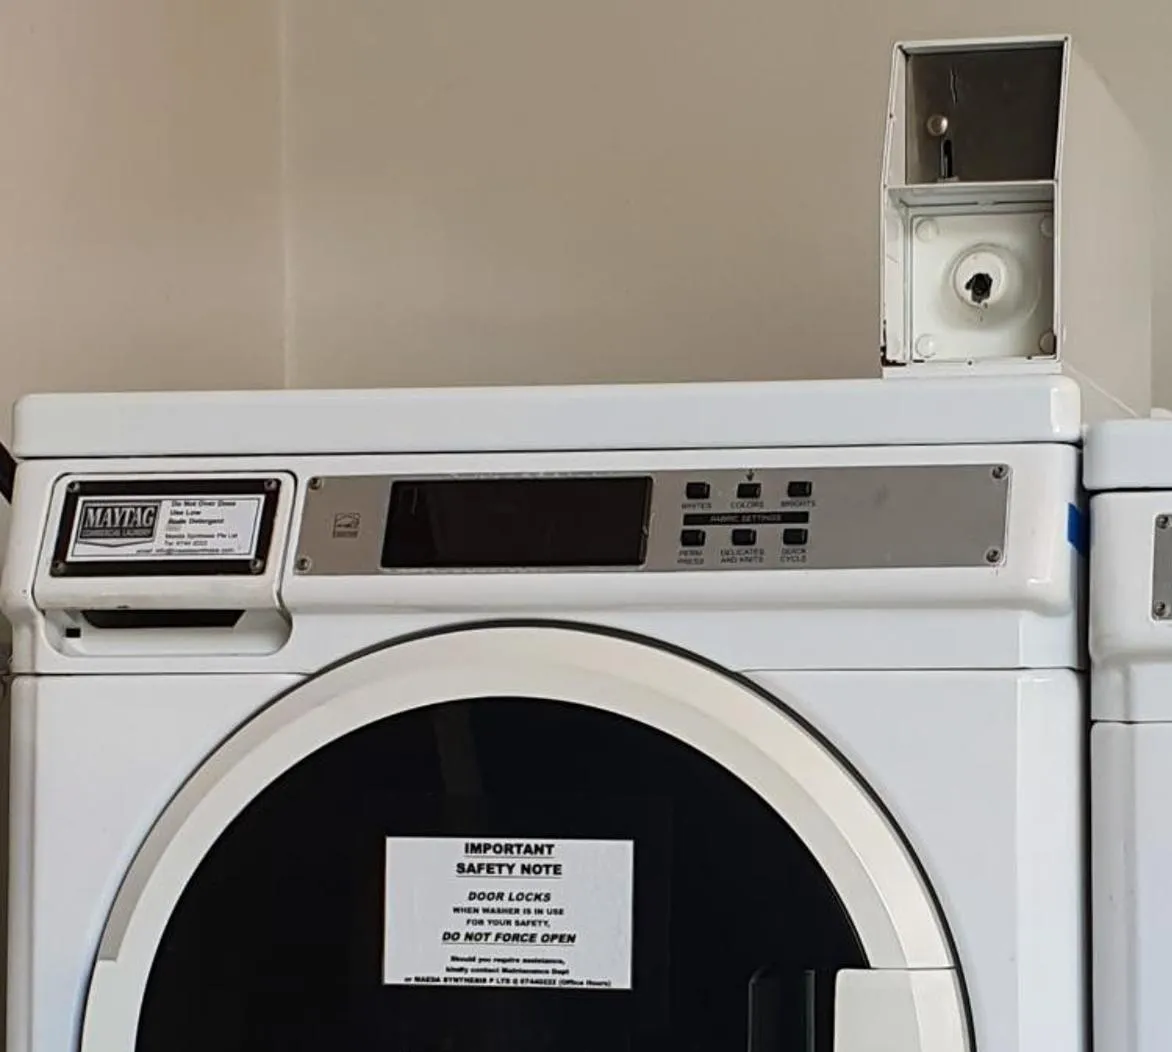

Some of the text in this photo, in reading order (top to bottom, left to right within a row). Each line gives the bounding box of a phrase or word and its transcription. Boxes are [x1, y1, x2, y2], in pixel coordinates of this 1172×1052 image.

[85, 507, 155, 527] MAYTAG
[464, 842, 556, 856] IMPORTANT
[456, 862, 563, 876] SAFETY NOTE
[468, 891, 552, 903] DOOR LOCKS
[452, 906, 565, 916] WHEN WASHER IS IN USE
[466, 918, 485, 927] FOR
[487, 918, 512, 927] YOUR
[442, 931, 577, 945] DO NOT FORCE OPEN
